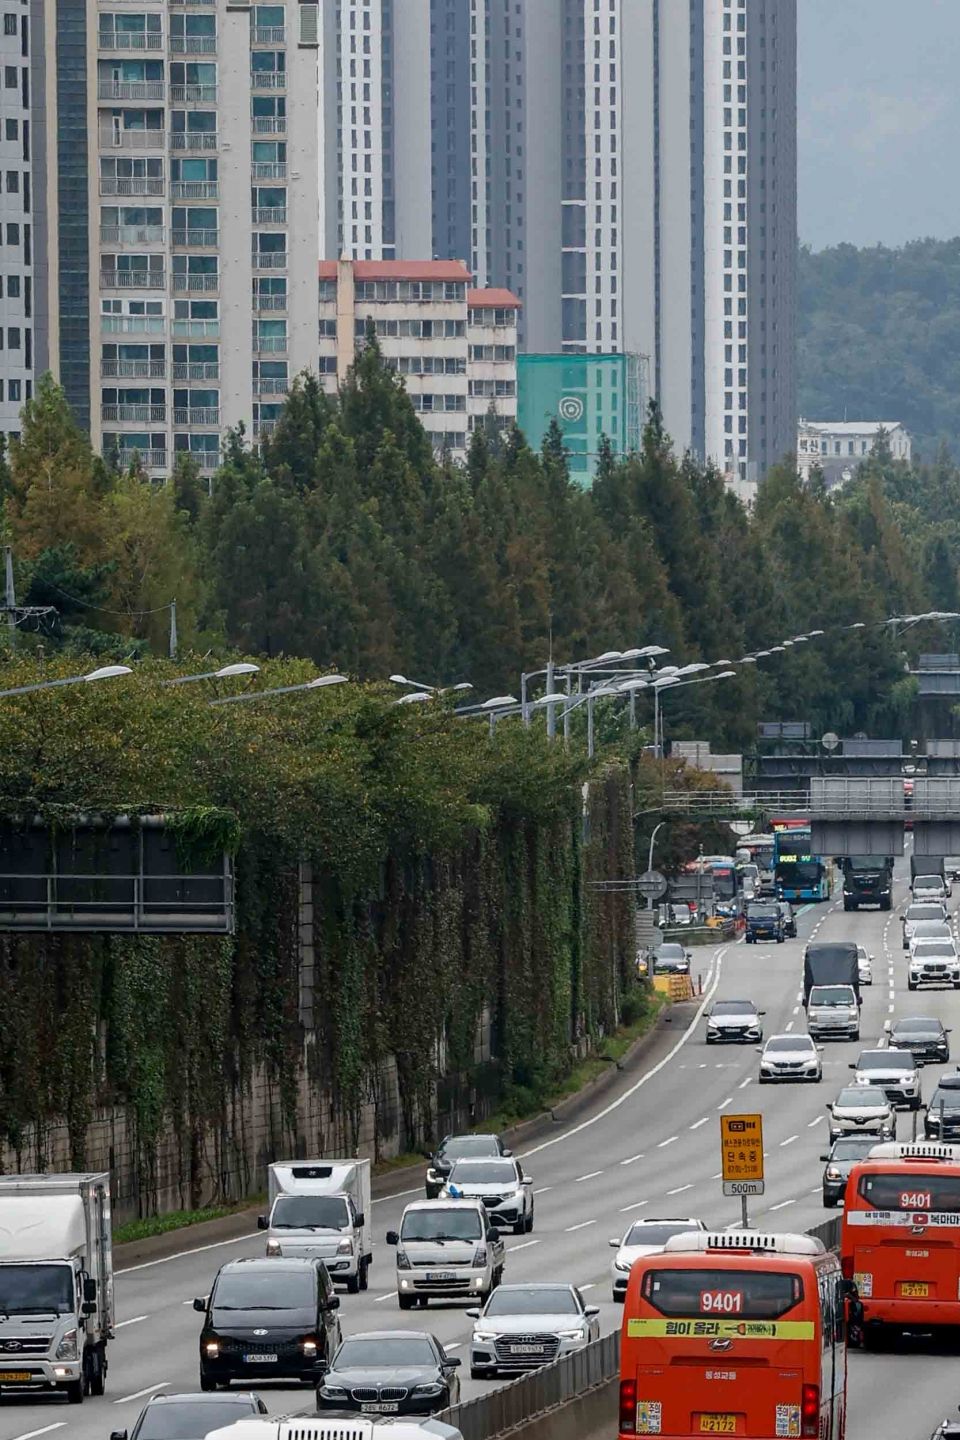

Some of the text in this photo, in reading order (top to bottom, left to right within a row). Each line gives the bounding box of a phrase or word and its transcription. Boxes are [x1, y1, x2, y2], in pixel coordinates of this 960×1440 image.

[731, 1184, 757, 1193] 500m
[902, 1193, 930, 1207] 9401
[703, 1293, 741, 1311] 9401
[666, 1322, 720, 1335] 힘이 올라
[709, 1421, 734, 1430] 2172
